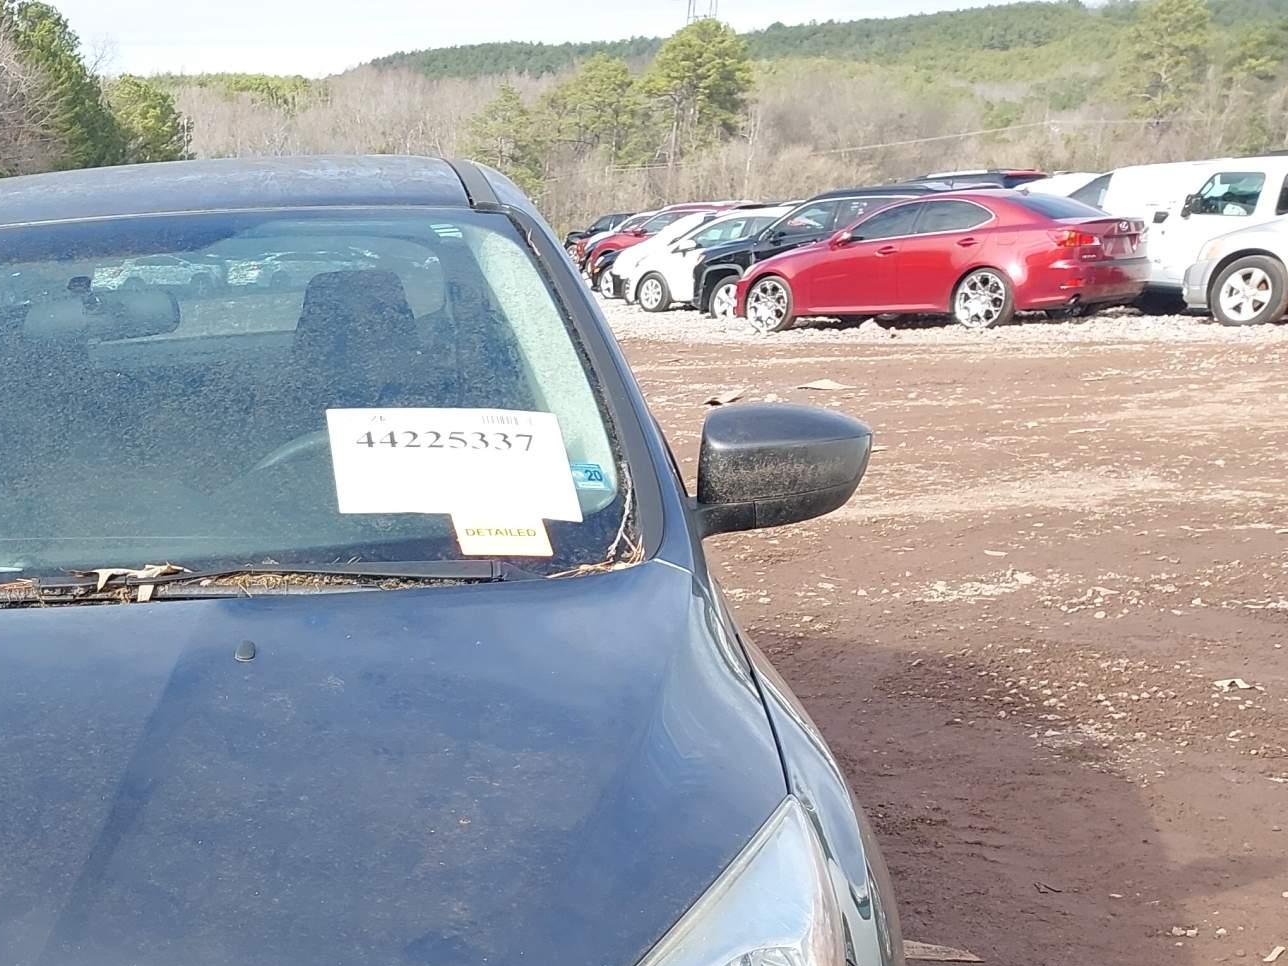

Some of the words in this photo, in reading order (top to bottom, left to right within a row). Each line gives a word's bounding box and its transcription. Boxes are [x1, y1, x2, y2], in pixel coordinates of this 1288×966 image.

[355, 430, 534, 452] 44225337
[584, 469, 604, 482] 20
[464, 527, 537, 538] DETAILED
